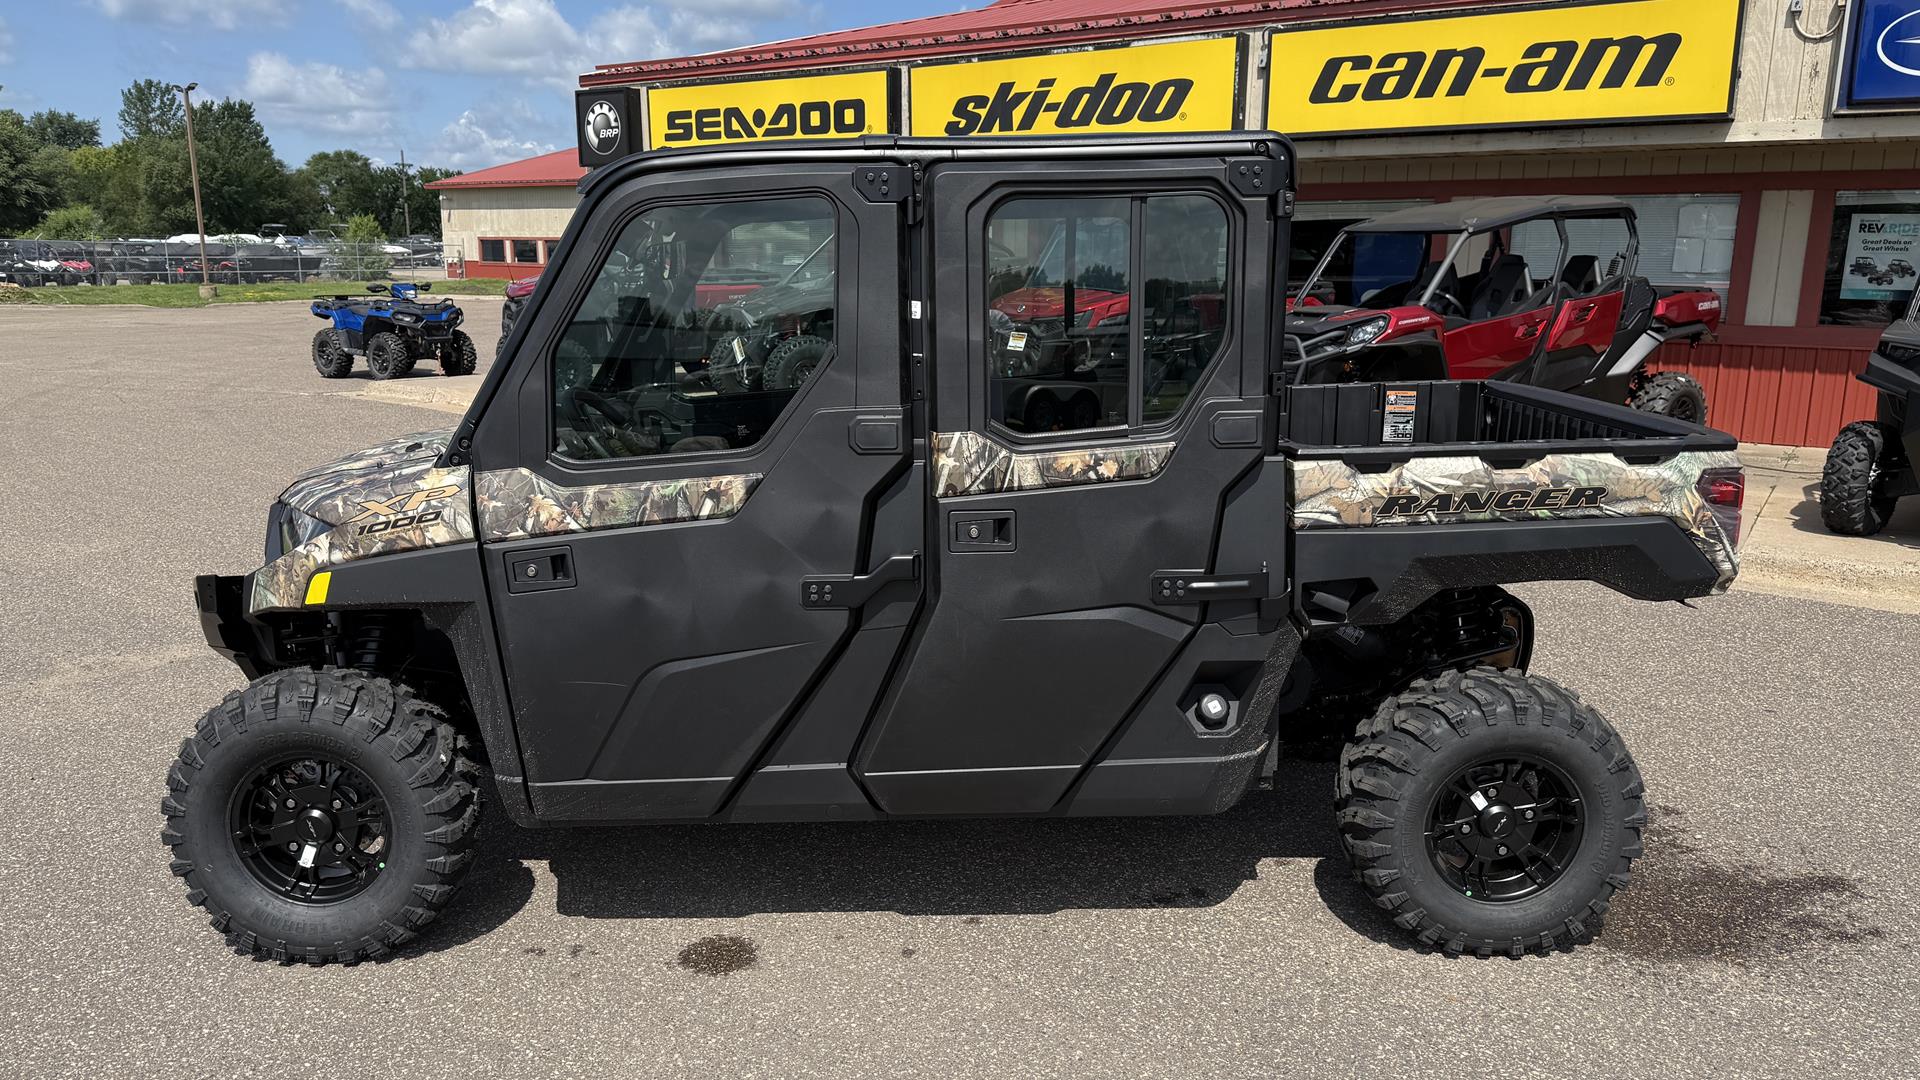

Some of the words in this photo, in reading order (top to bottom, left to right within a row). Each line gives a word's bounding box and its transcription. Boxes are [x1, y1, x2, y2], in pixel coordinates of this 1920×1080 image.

[1309, 32, 1682, 104] can-am
[944, 72, 1194, 136] ski-doo
[599, 128, 619, 138] BRP
[341, 484, 462, 524] XP
[1375, 485, 1609, 517] RANGER
[357, 510, 443, 536] 1000
